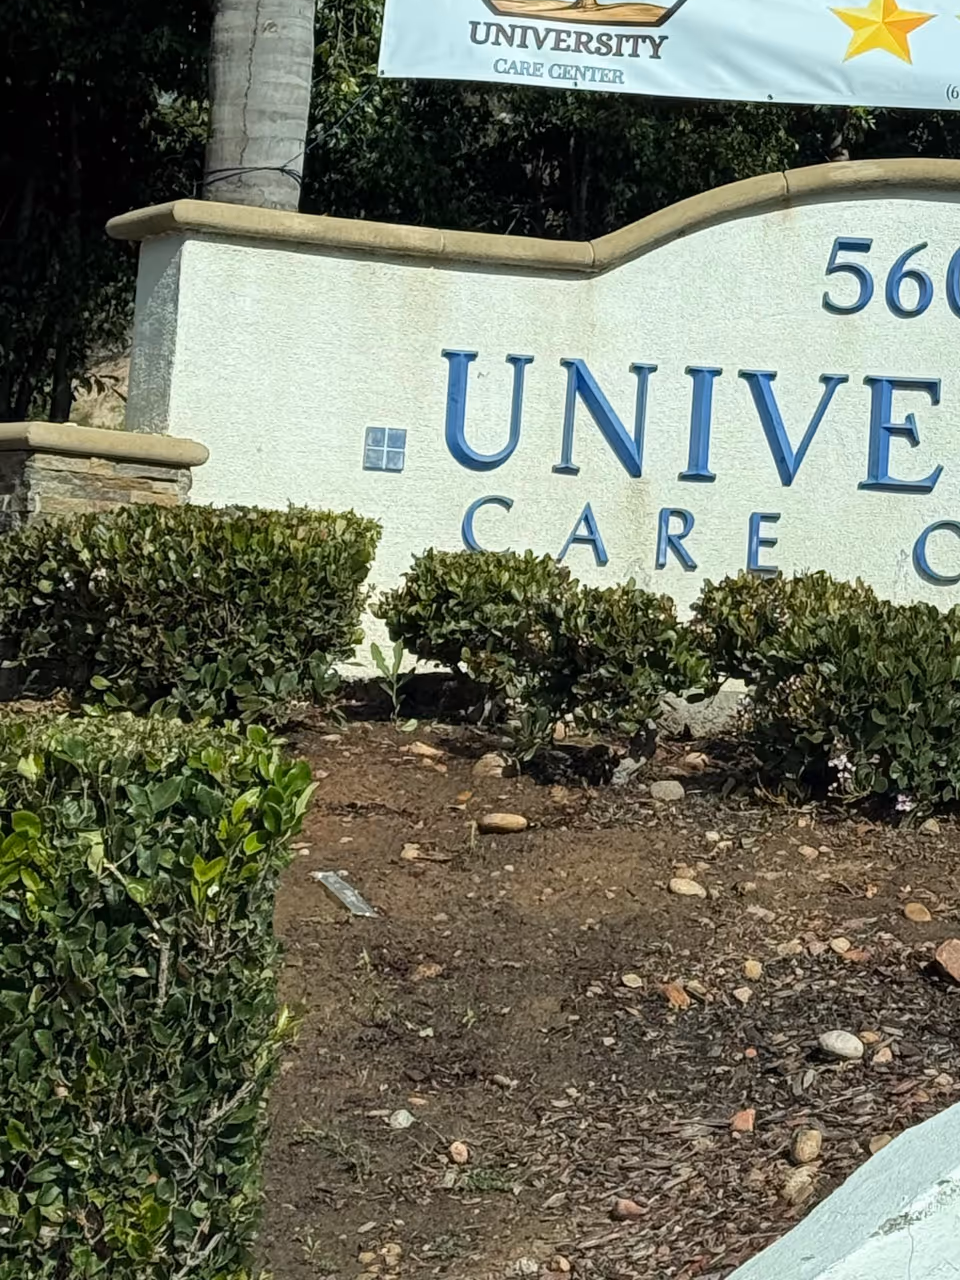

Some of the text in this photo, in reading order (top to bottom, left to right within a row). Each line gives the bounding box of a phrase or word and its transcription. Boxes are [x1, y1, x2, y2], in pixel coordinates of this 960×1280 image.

[469, 21, 669, 58] UNIVERSITY
[493, 58, 625, 84] CARE CENTER
[461, 494, 782, 576] CARE
